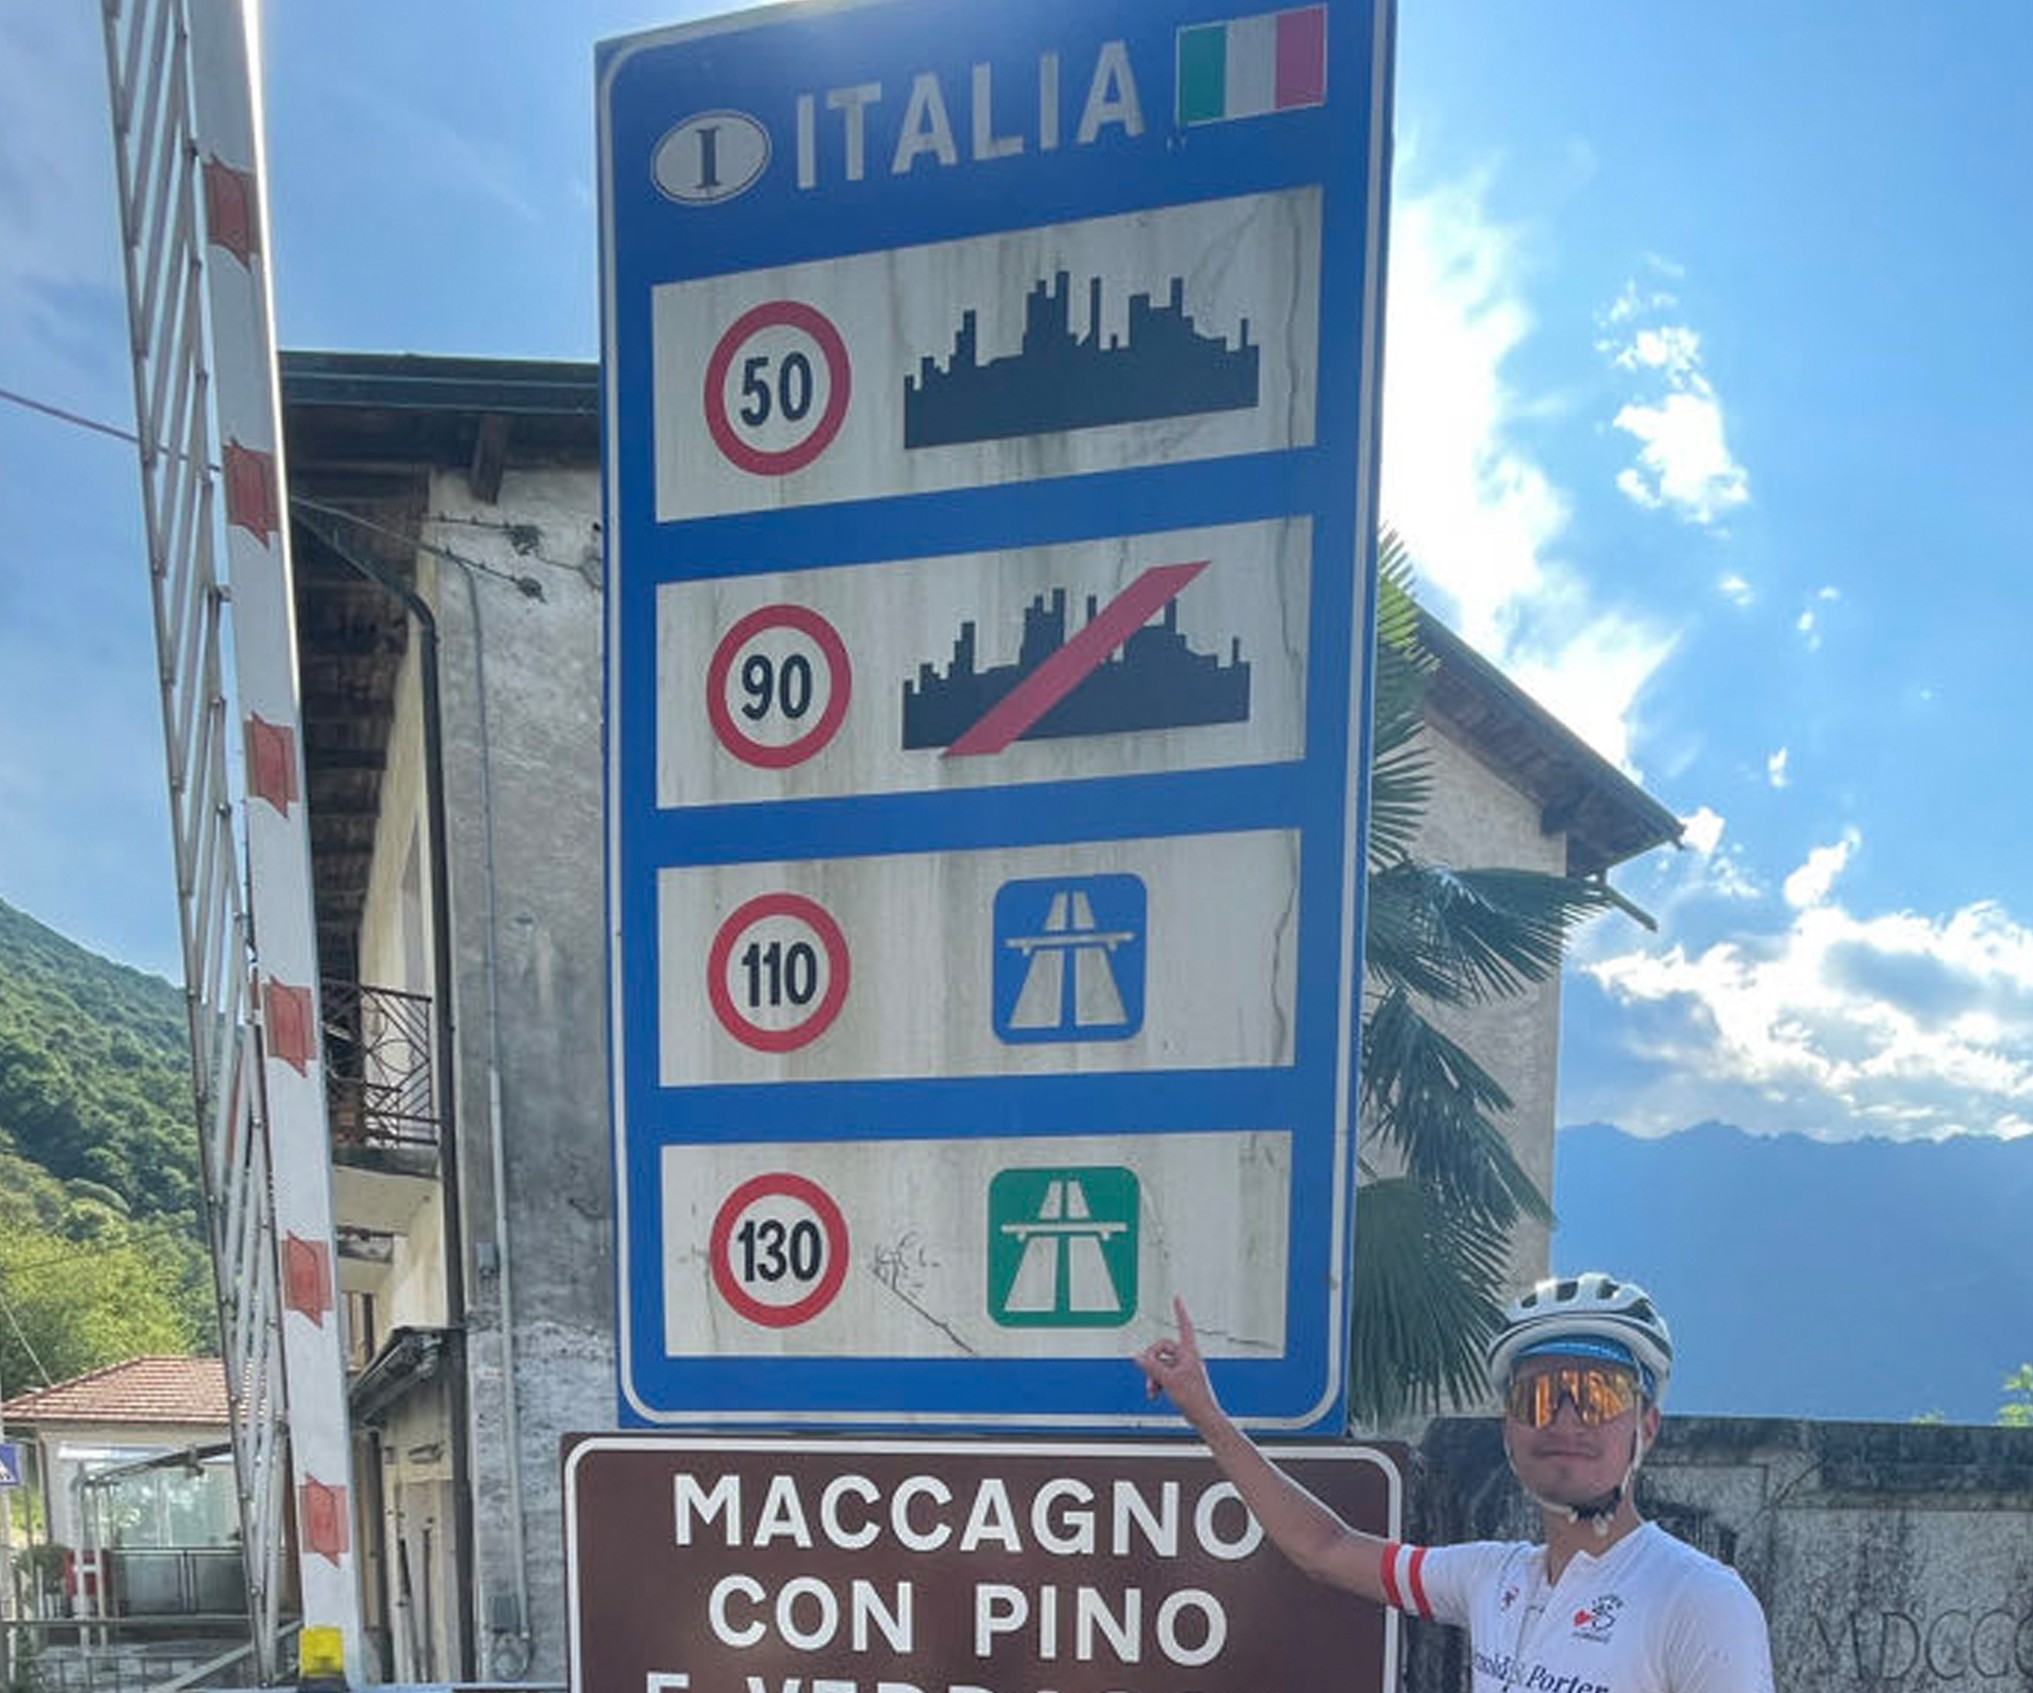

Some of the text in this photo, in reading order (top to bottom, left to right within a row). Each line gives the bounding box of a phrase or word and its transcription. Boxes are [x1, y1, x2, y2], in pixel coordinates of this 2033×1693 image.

[797, 40, 1144, 189] ITALIA
[695, 126, 721, 193] I
[740, 352, 813, 427] 50
[741, 654, 812, 721] 90
[742, 942, 817, 1007] 110
[738, 1220, 822, 1282] 130
[674, 1473, 1265, 1561] MACCAGNO
[708, 1574, 1228, 1666] CON PINO
